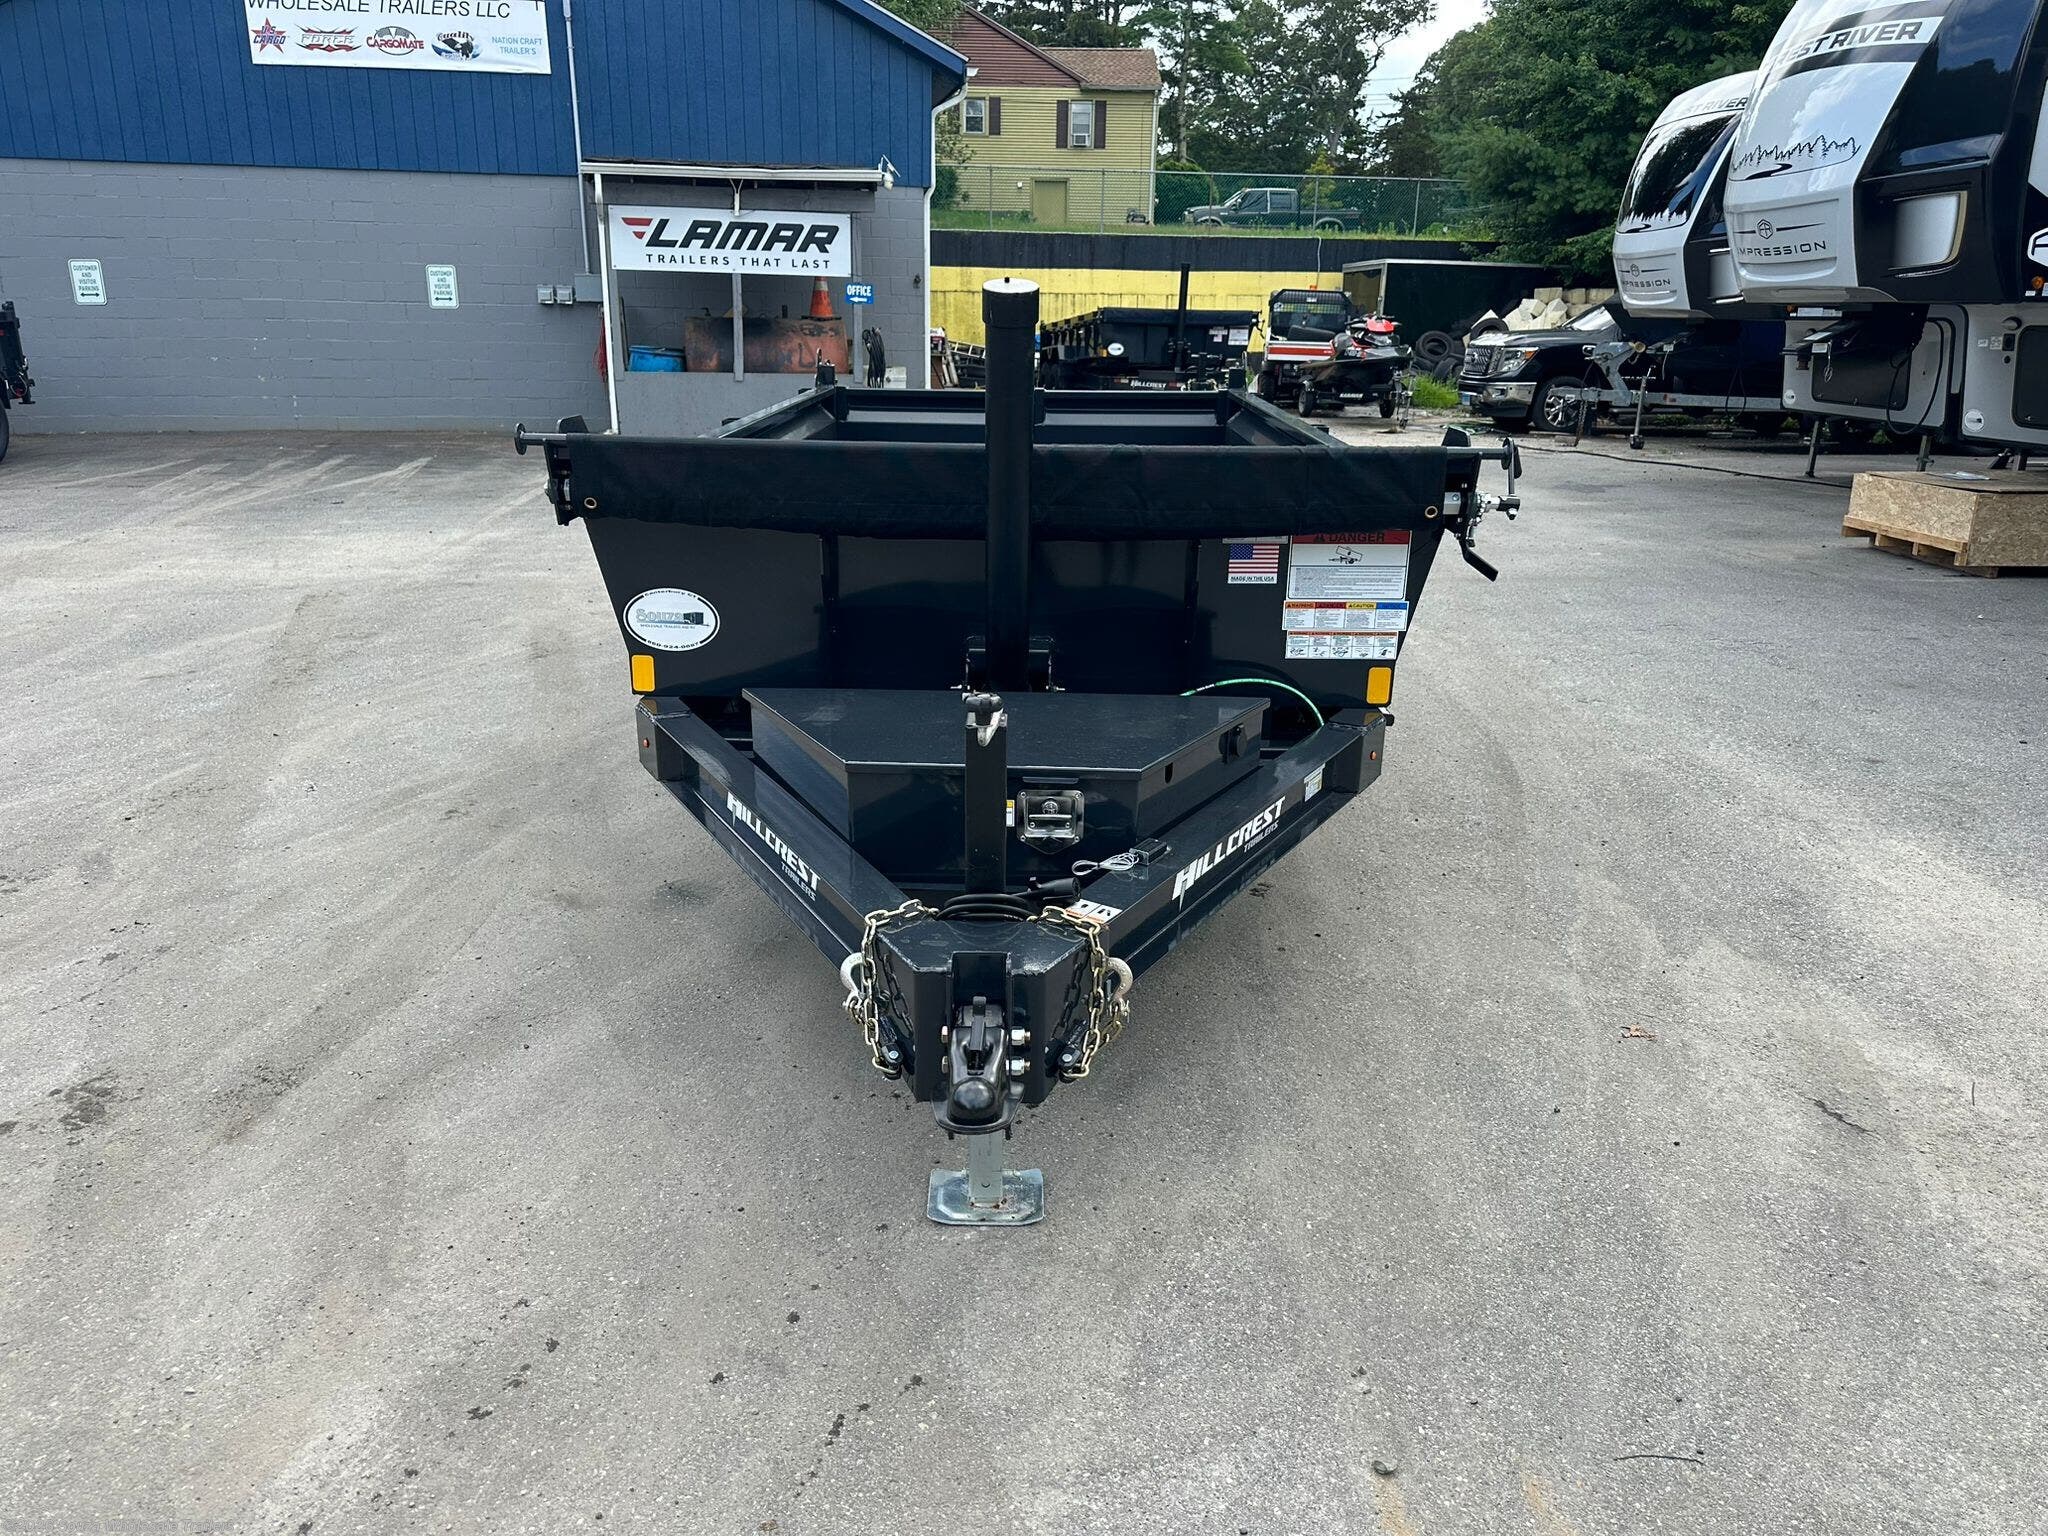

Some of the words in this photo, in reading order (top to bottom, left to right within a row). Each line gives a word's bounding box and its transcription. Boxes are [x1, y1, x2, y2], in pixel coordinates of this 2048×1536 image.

[249, 0, 370, 13] WHOLESALE
[376, 0, 470, 17] TRAILERS
[476, 1, 510, 18] LLC
[253, 34, 286, 45] CARGO
[491, 36, 519, 45] NATION
[520, 37, 543, 46] CRAFT
[1828, 21, 1923, 49] RIVER
[645, 218, 840, 254] LAMAR
[645, 253, 731, 266] TRAILERS
[740, 256, 781, 268] THAT
[791, 258, 831, 270] LAST
[846, 284, 872, 297] OFFICE
[1130, 379, 1167, 388] HILLCREST
[1328, 532, 1385, 543] DANGER
[727, 791, 821, 892] HILLCREST
[1244, 820, 1279, 853] TRAILERS
[1172, 796, 1286, 908] HILLCREST
[781, 861, 817, 902] TRAILERS
